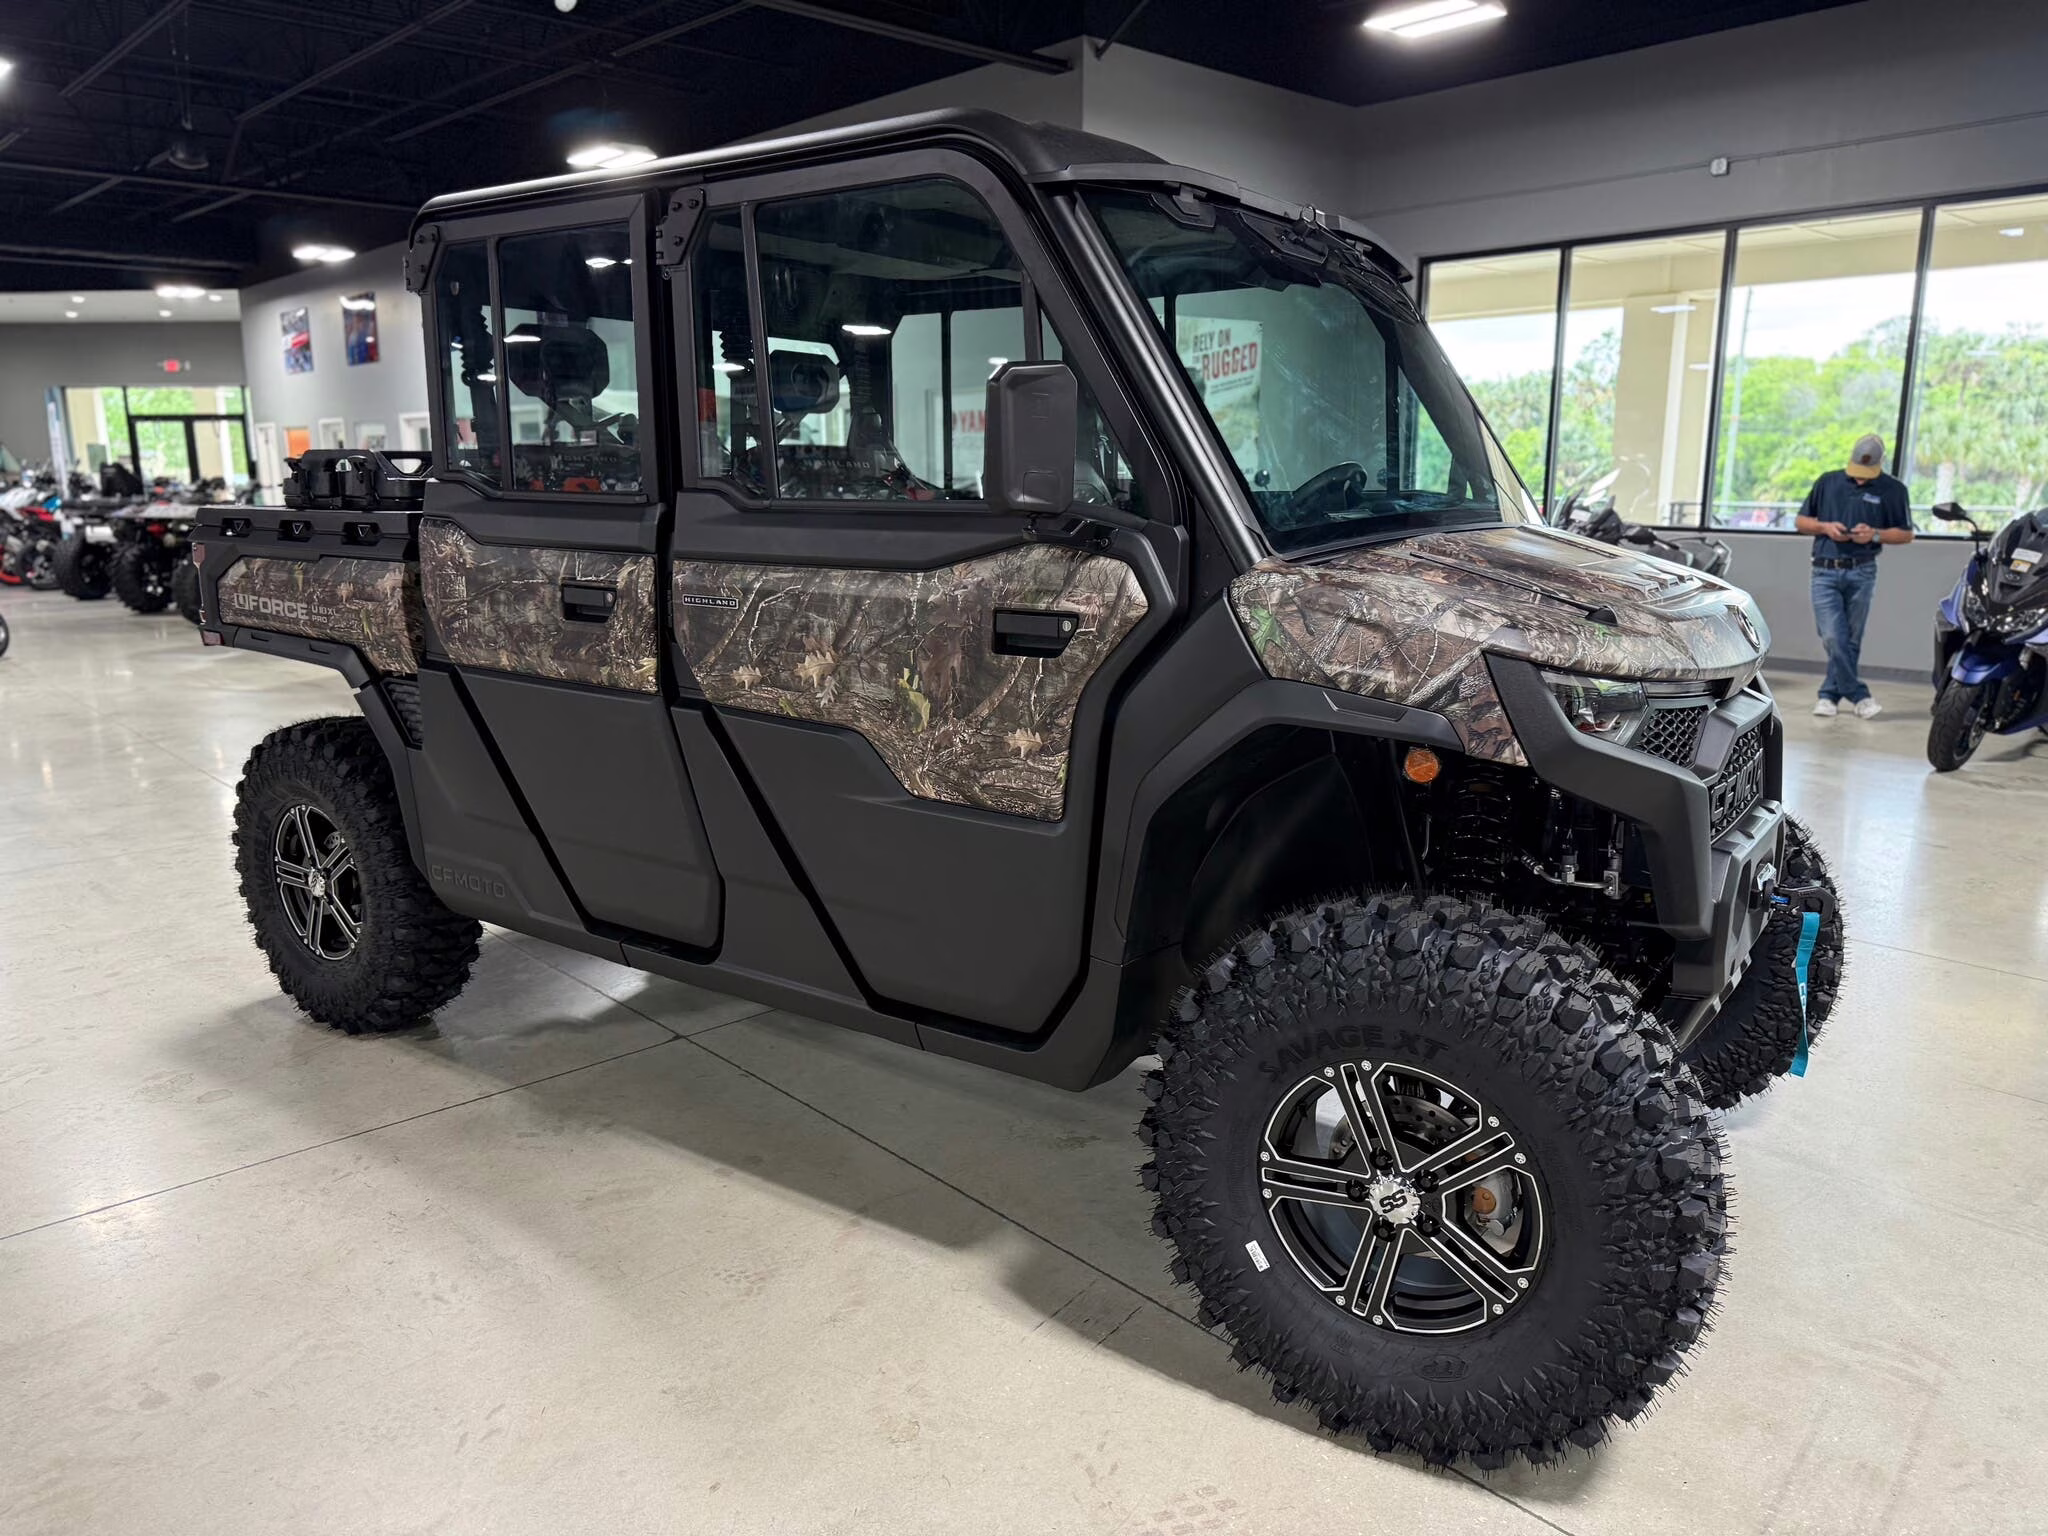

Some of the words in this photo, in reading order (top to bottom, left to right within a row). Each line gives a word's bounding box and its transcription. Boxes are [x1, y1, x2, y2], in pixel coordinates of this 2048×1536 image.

[1192, 330, 1215, 353] RELY
[1217, 327, 1231, 348] ON
[1202, 341, 1258, 381] RUGGED
[684, 596, 736, 606] HIGHLAND
[431, 865, 505, 898] CFMOTO
